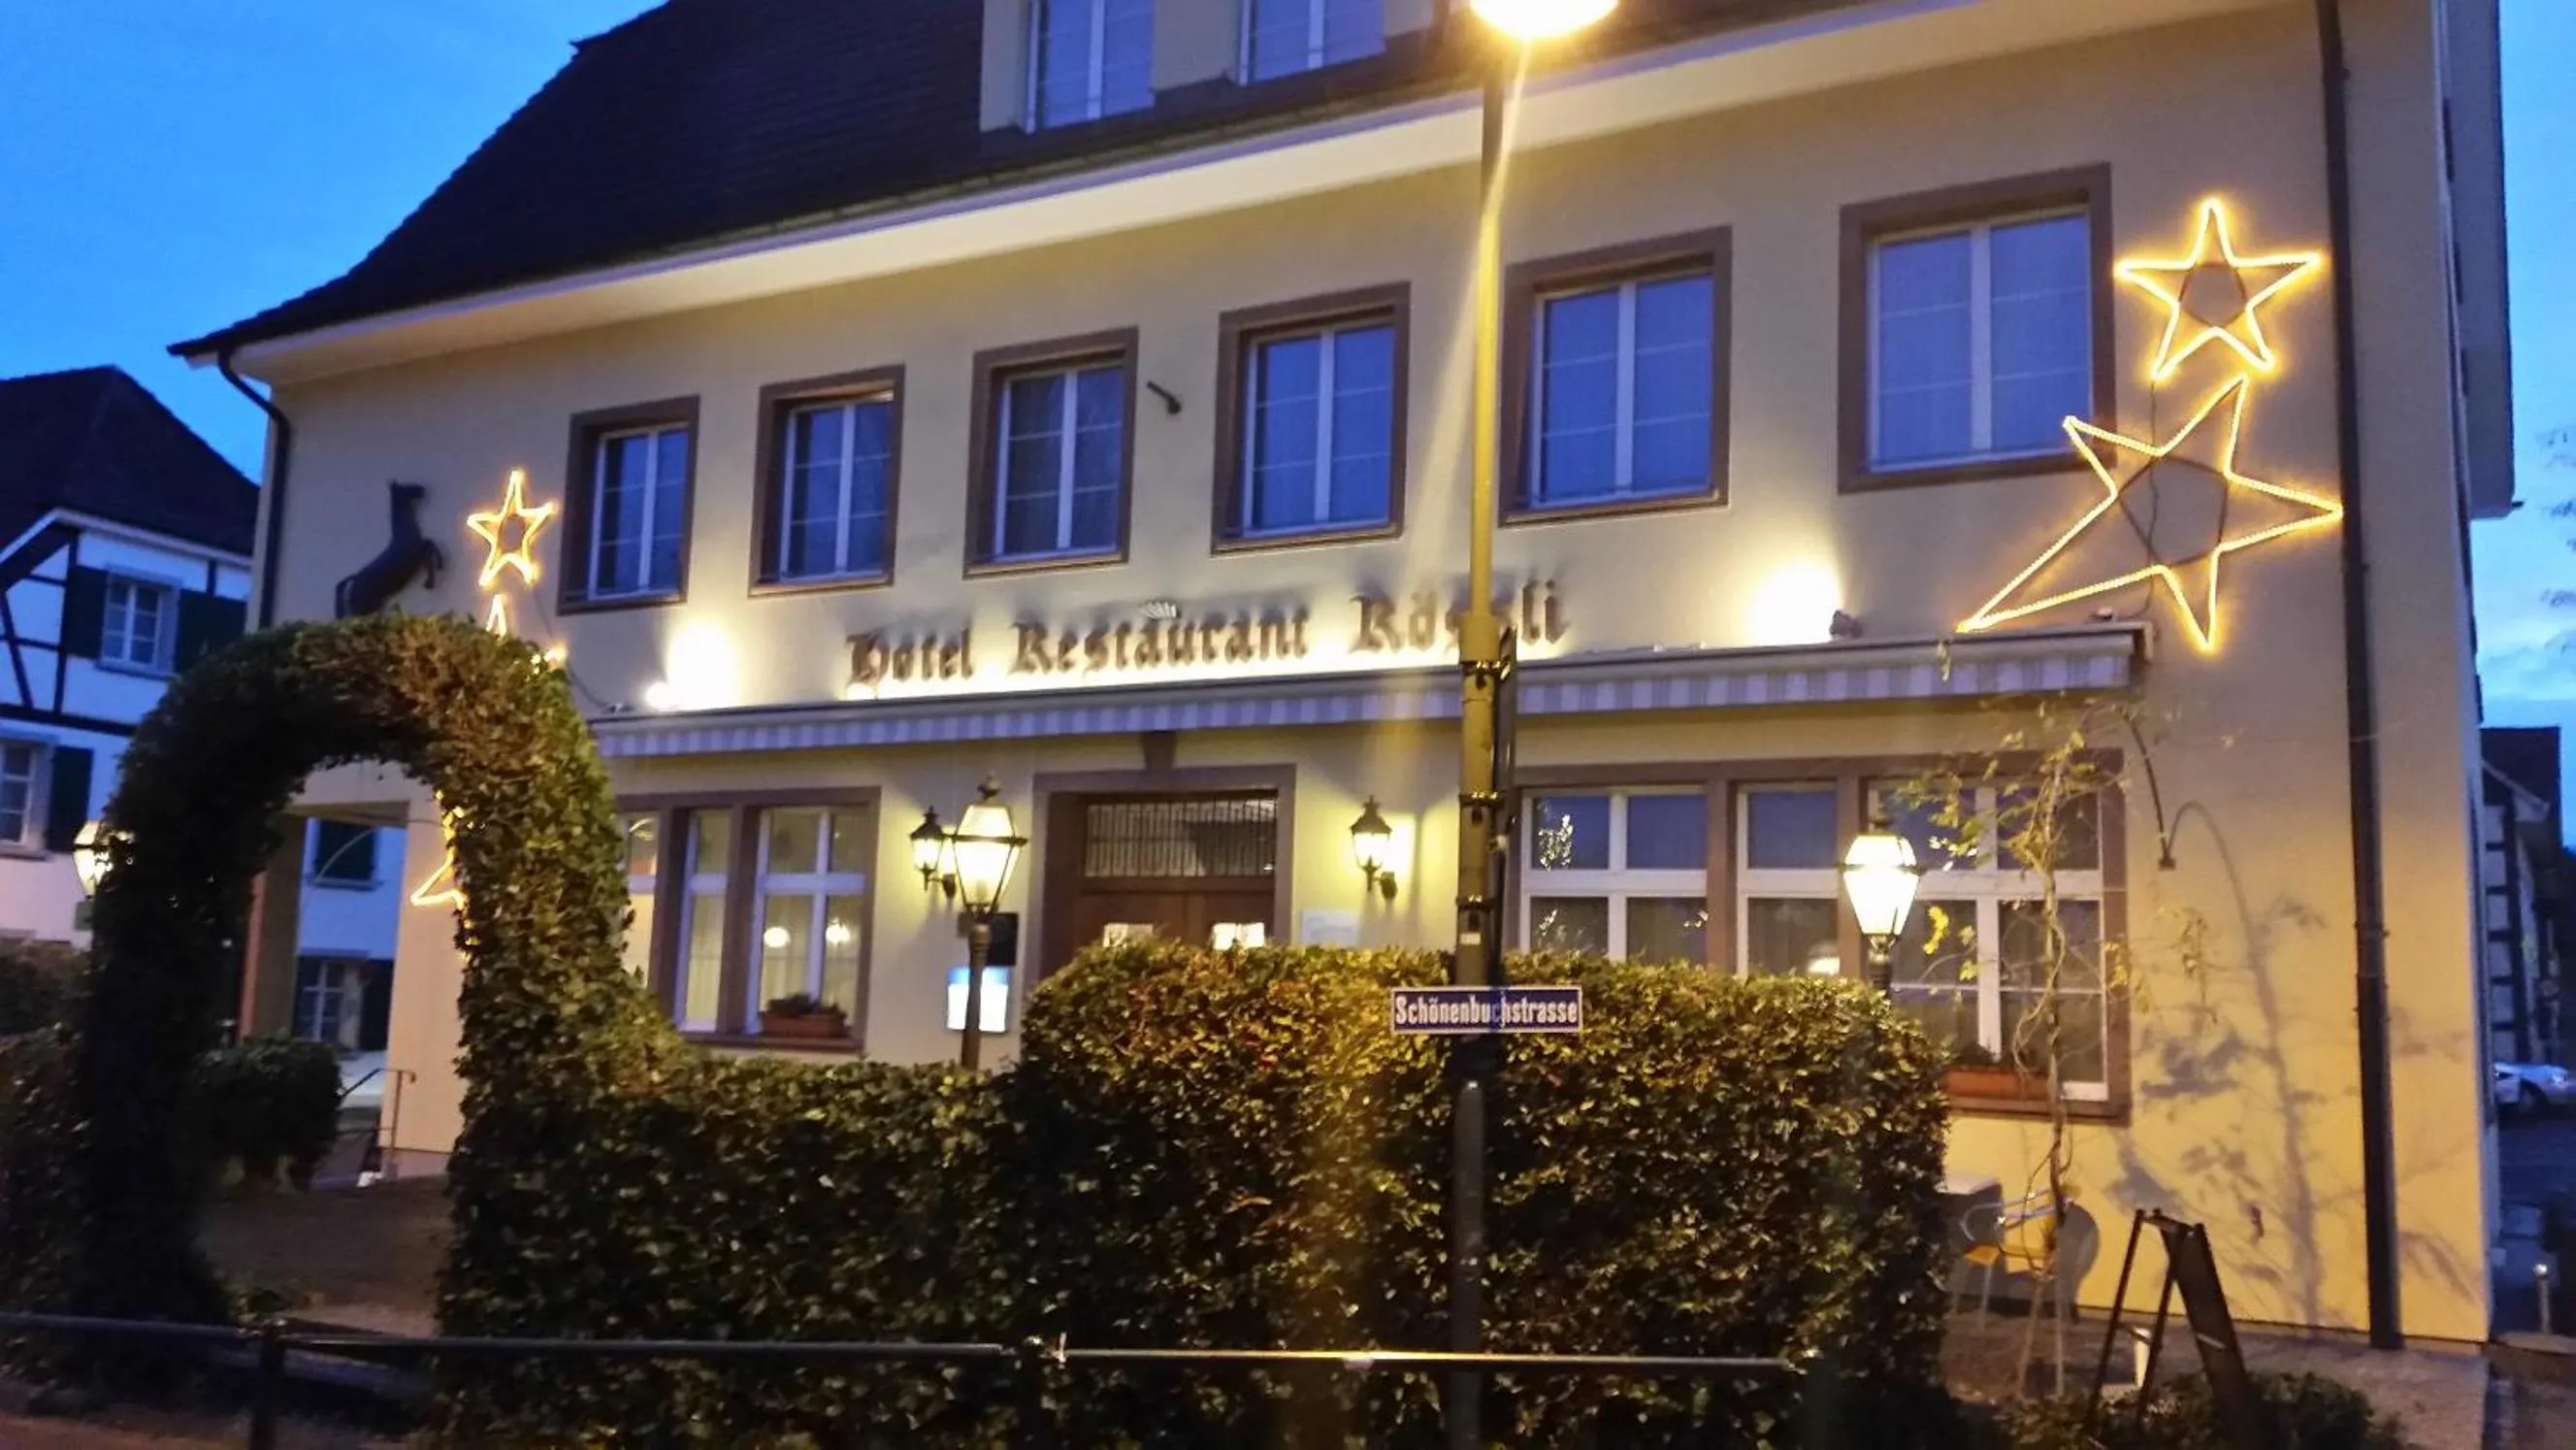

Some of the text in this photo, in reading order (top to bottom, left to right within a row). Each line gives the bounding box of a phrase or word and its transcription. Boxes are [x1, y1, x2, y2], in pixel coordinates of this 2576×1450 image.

[846, 627, 973, 684] Hotel
[1009, 608, 1309, 676] Restaurant
[1395, 994, 1578, 1026] Schönenbuchstrasse
